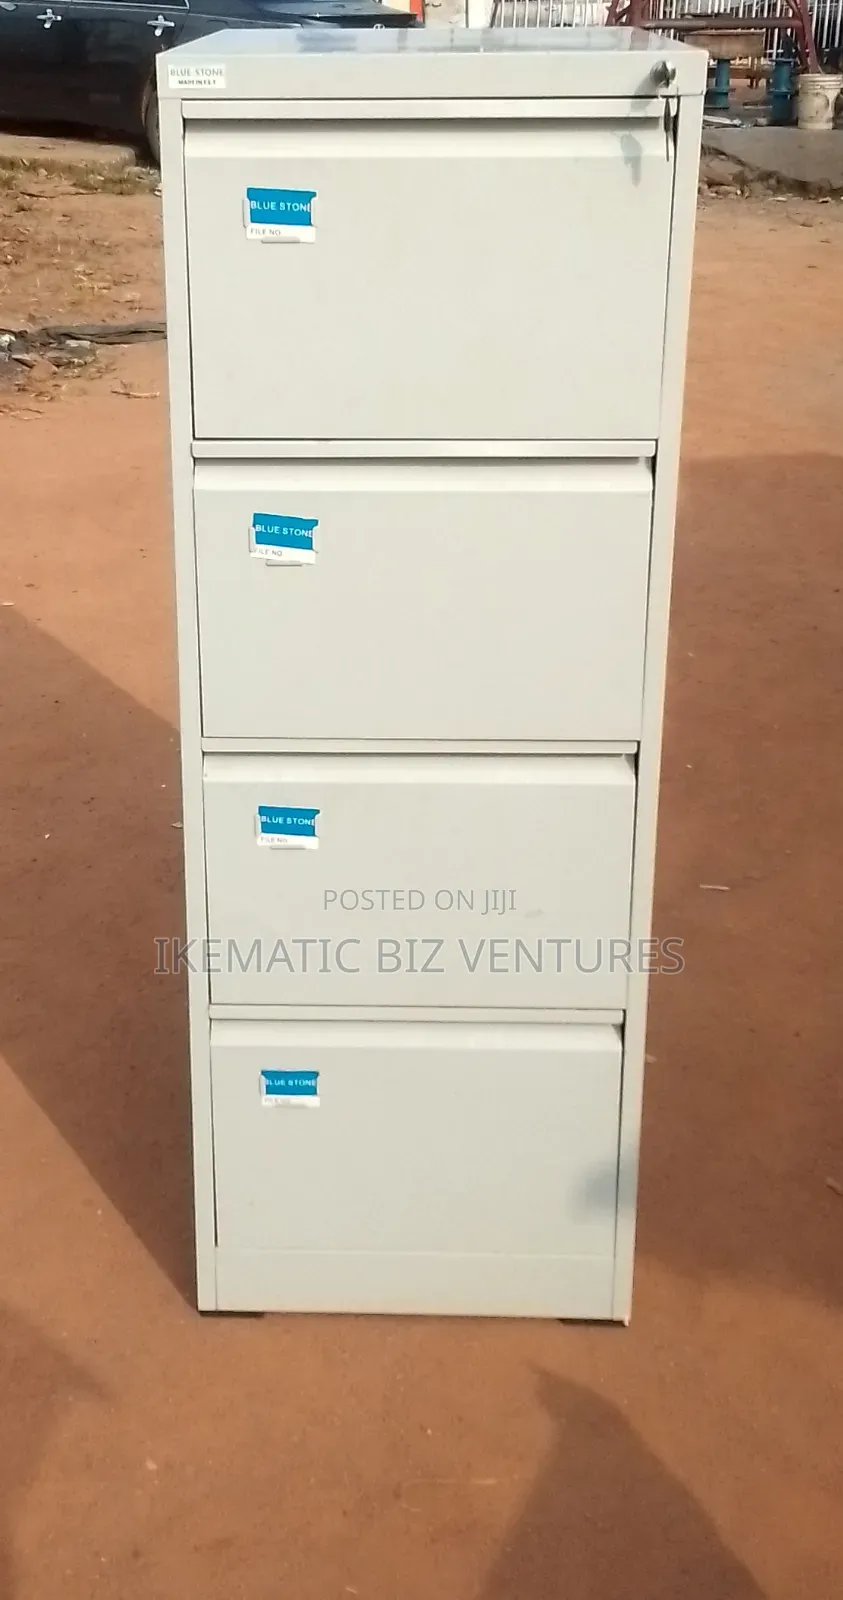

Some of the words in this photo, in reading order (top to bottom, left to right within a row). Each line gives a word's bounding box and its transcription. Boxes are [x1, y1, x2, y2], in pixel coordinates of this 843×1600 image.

[170, 68, 191, 77] BLUE
[195, 68, 224, 77] STONE
[250, 200, 276, 211] BLUE
[255, 524, 280, 534] BLUE
[261, 815, 284, 824] BLUE
